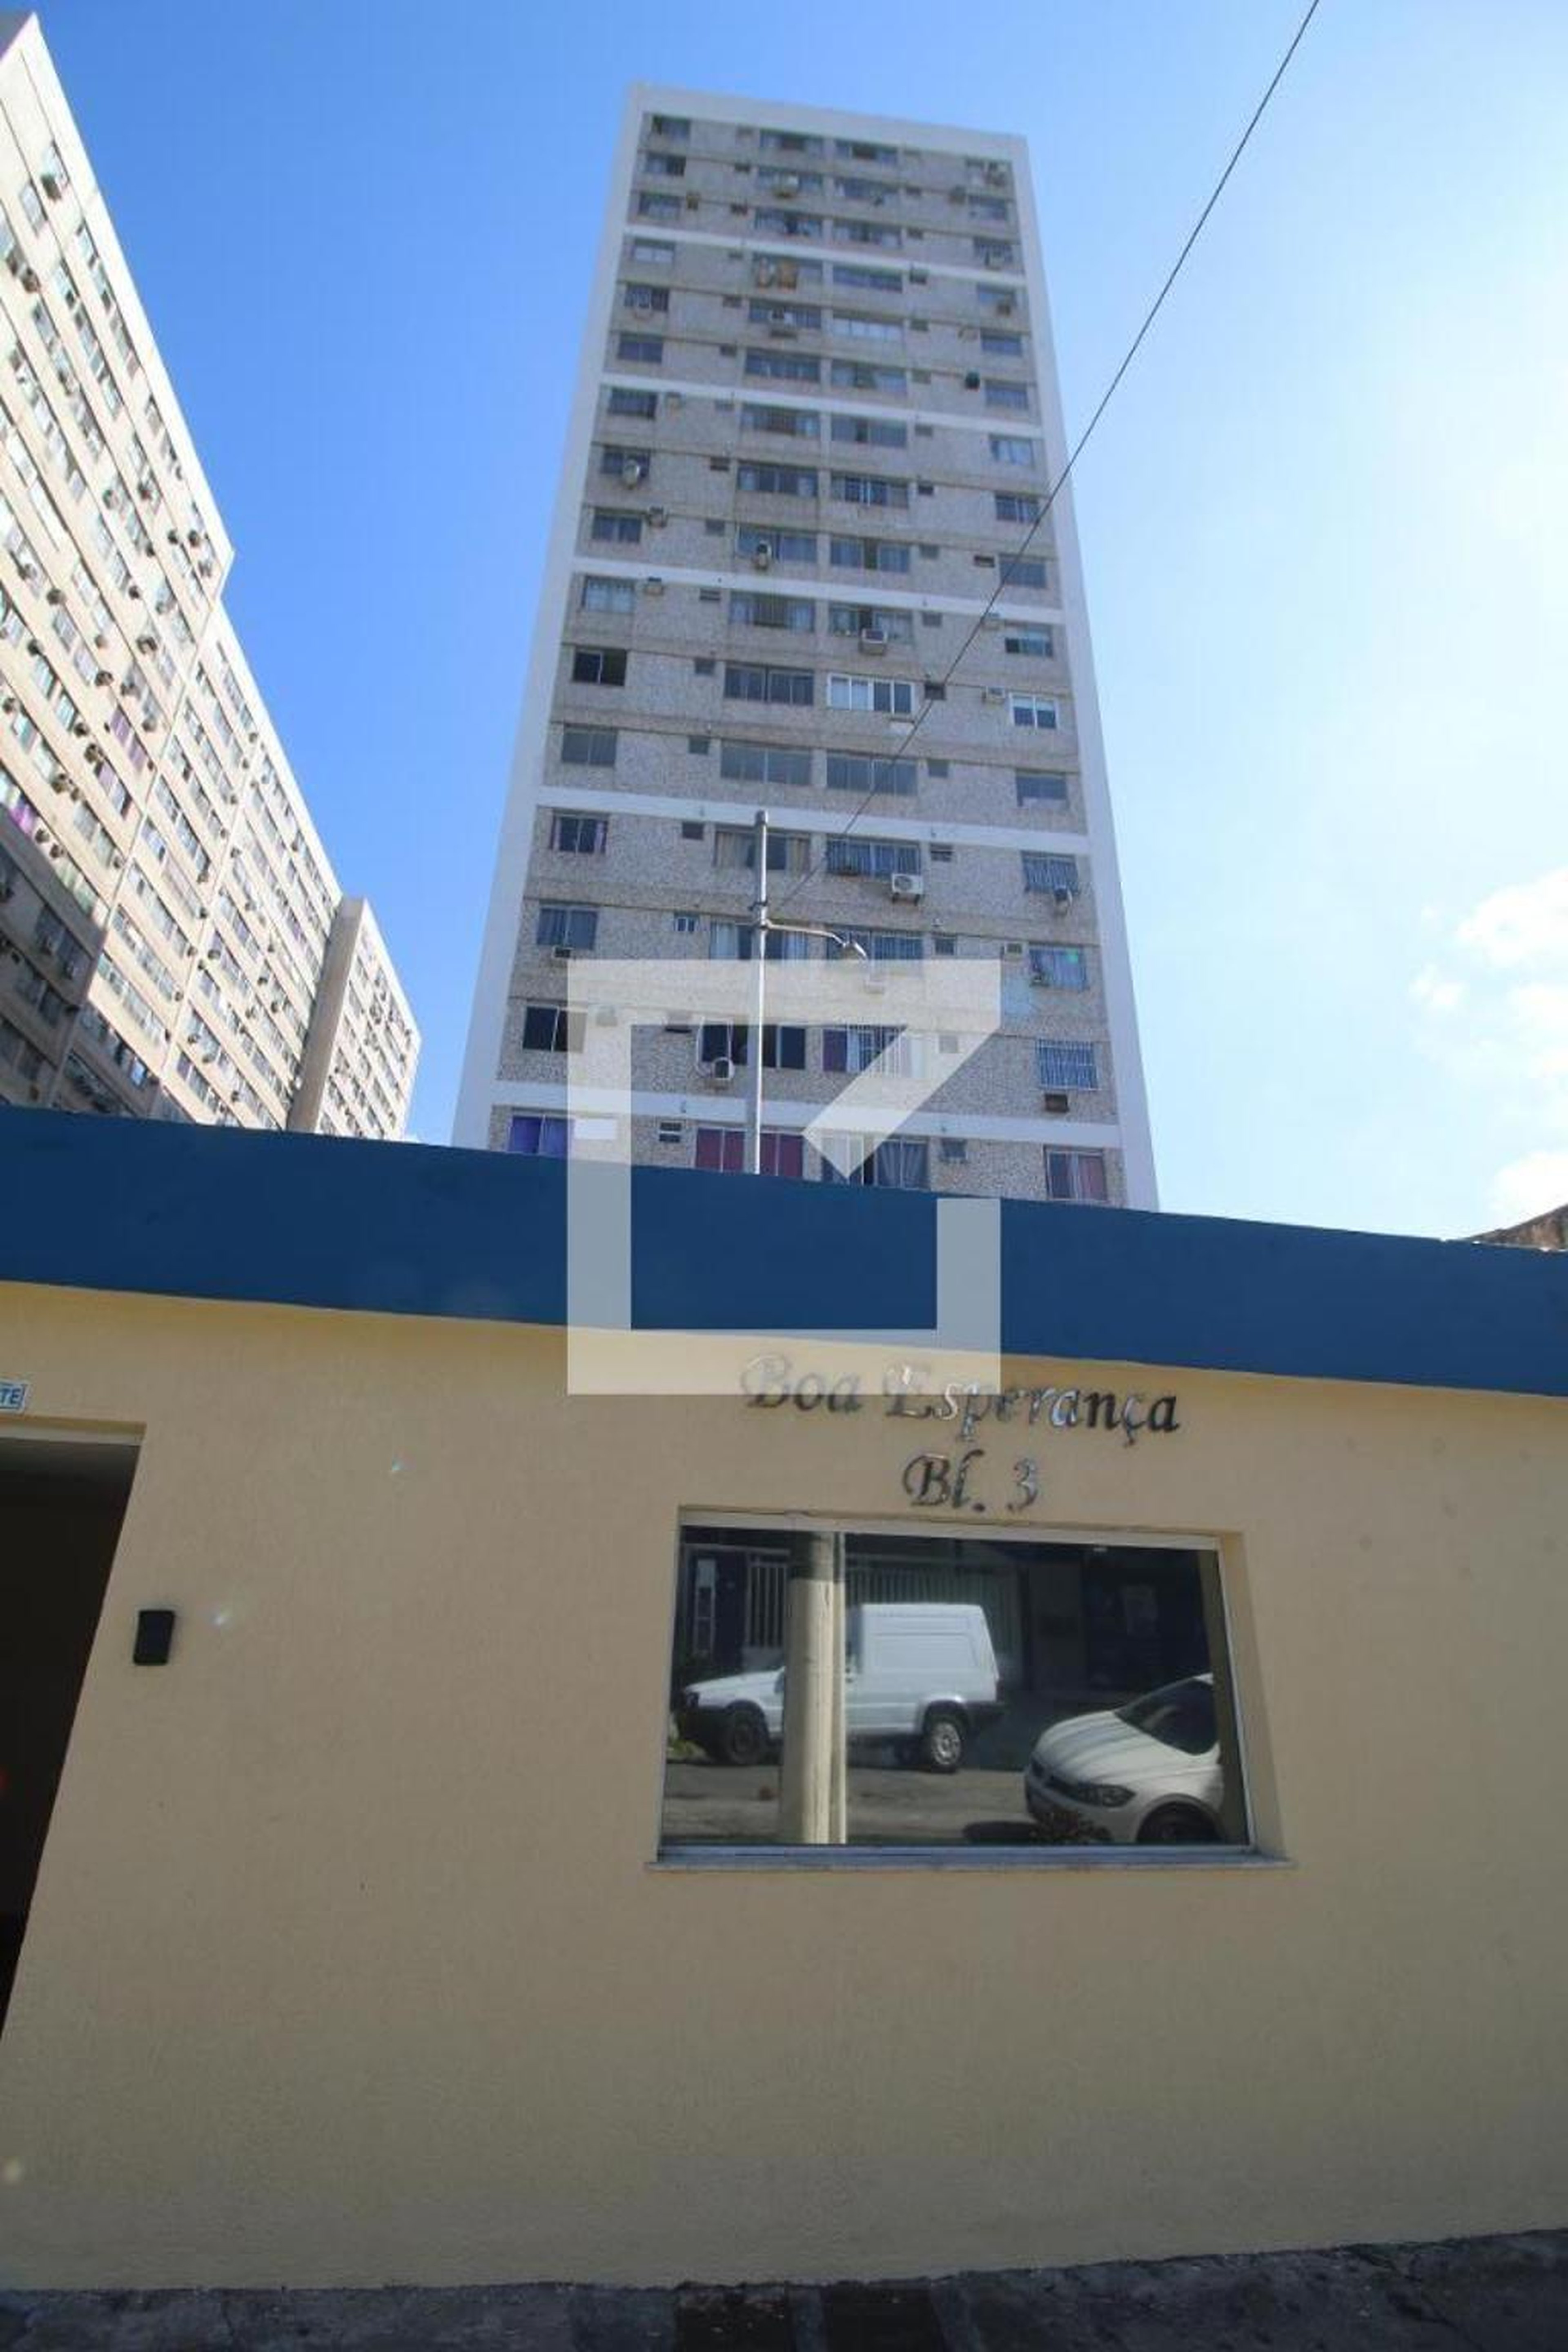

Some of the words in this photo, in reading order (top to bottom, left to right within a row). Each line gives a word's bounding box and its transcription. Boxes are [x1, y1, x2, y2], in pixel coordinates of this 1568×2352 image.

[740, 1352, 862, 1412] Boa
[882, 1363, 1180, 1448] Esperança
[902, 1449, 986, 1512] Bl.
[1007, 1457, 1039, 1513] 3
